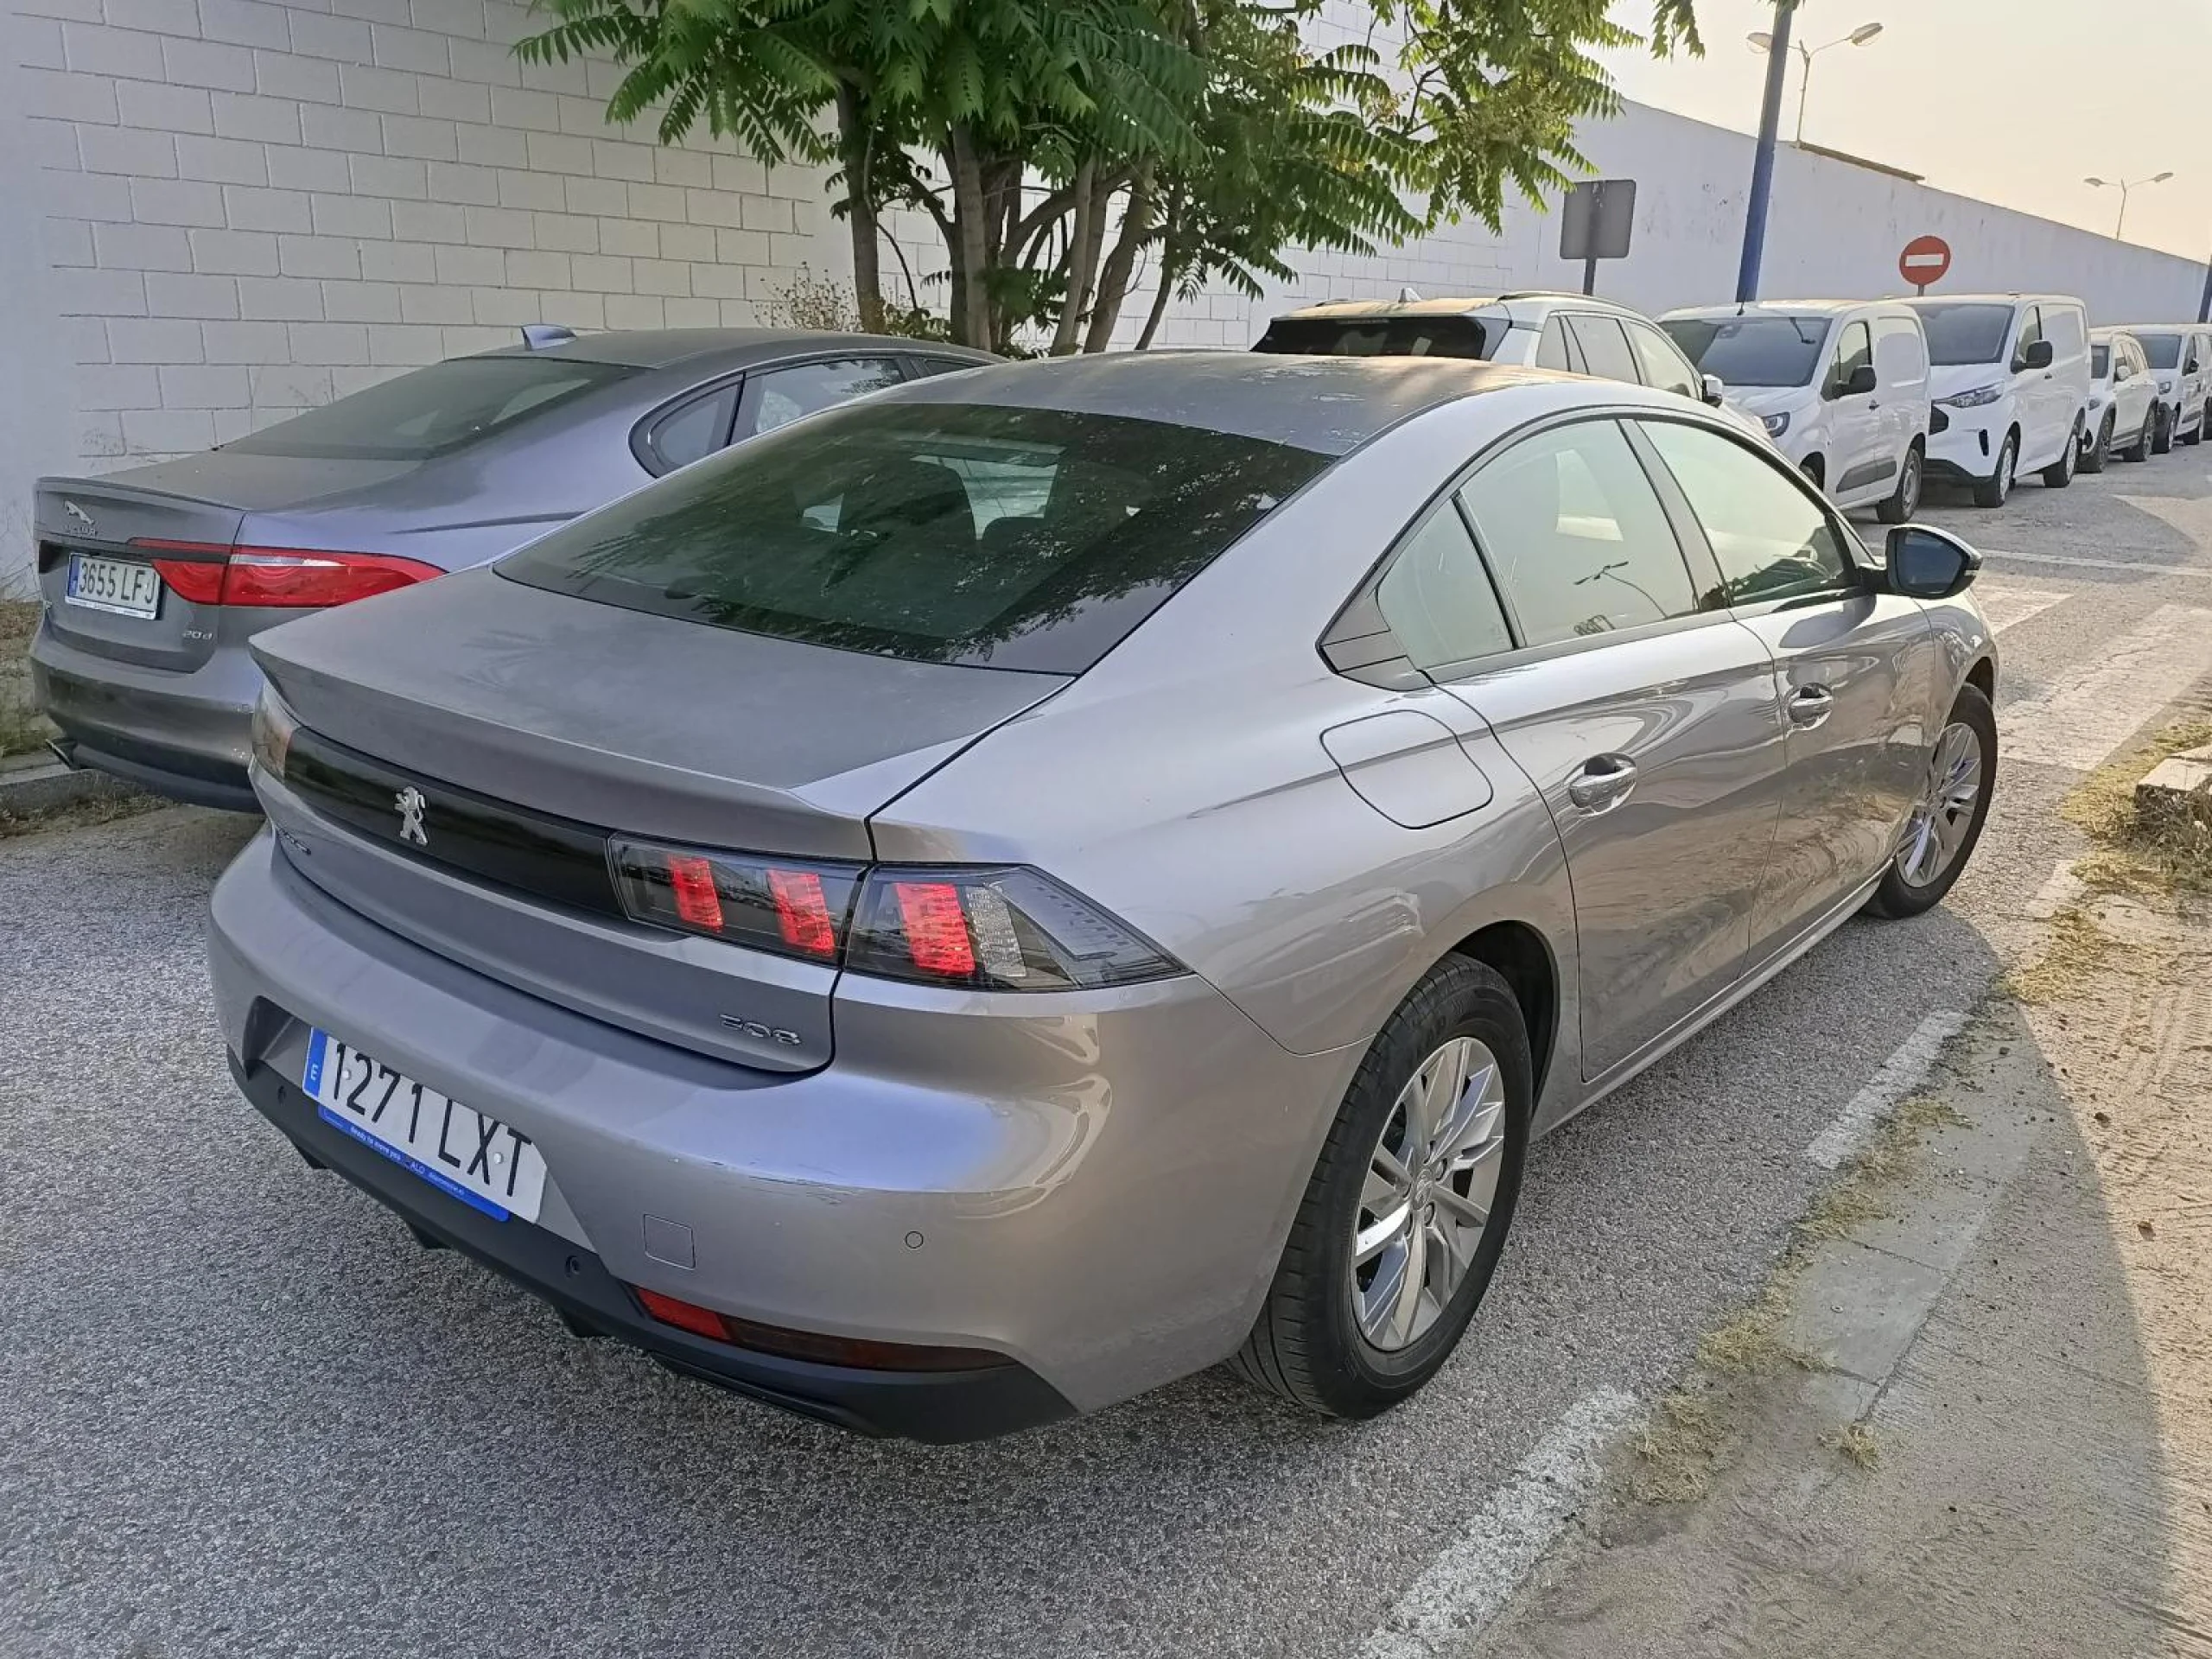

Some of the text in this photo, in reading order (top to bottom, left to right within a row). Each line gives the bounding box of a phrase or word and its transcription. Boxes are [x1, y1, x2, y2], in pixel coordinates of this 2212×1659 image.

[79, 563, 156, 604] 3655 LFJ
[719, 1014, 802, 1046] 508
[309, 1063, 320, 1082] E
[334, 1042, 532, 1198] 1271 LXT
